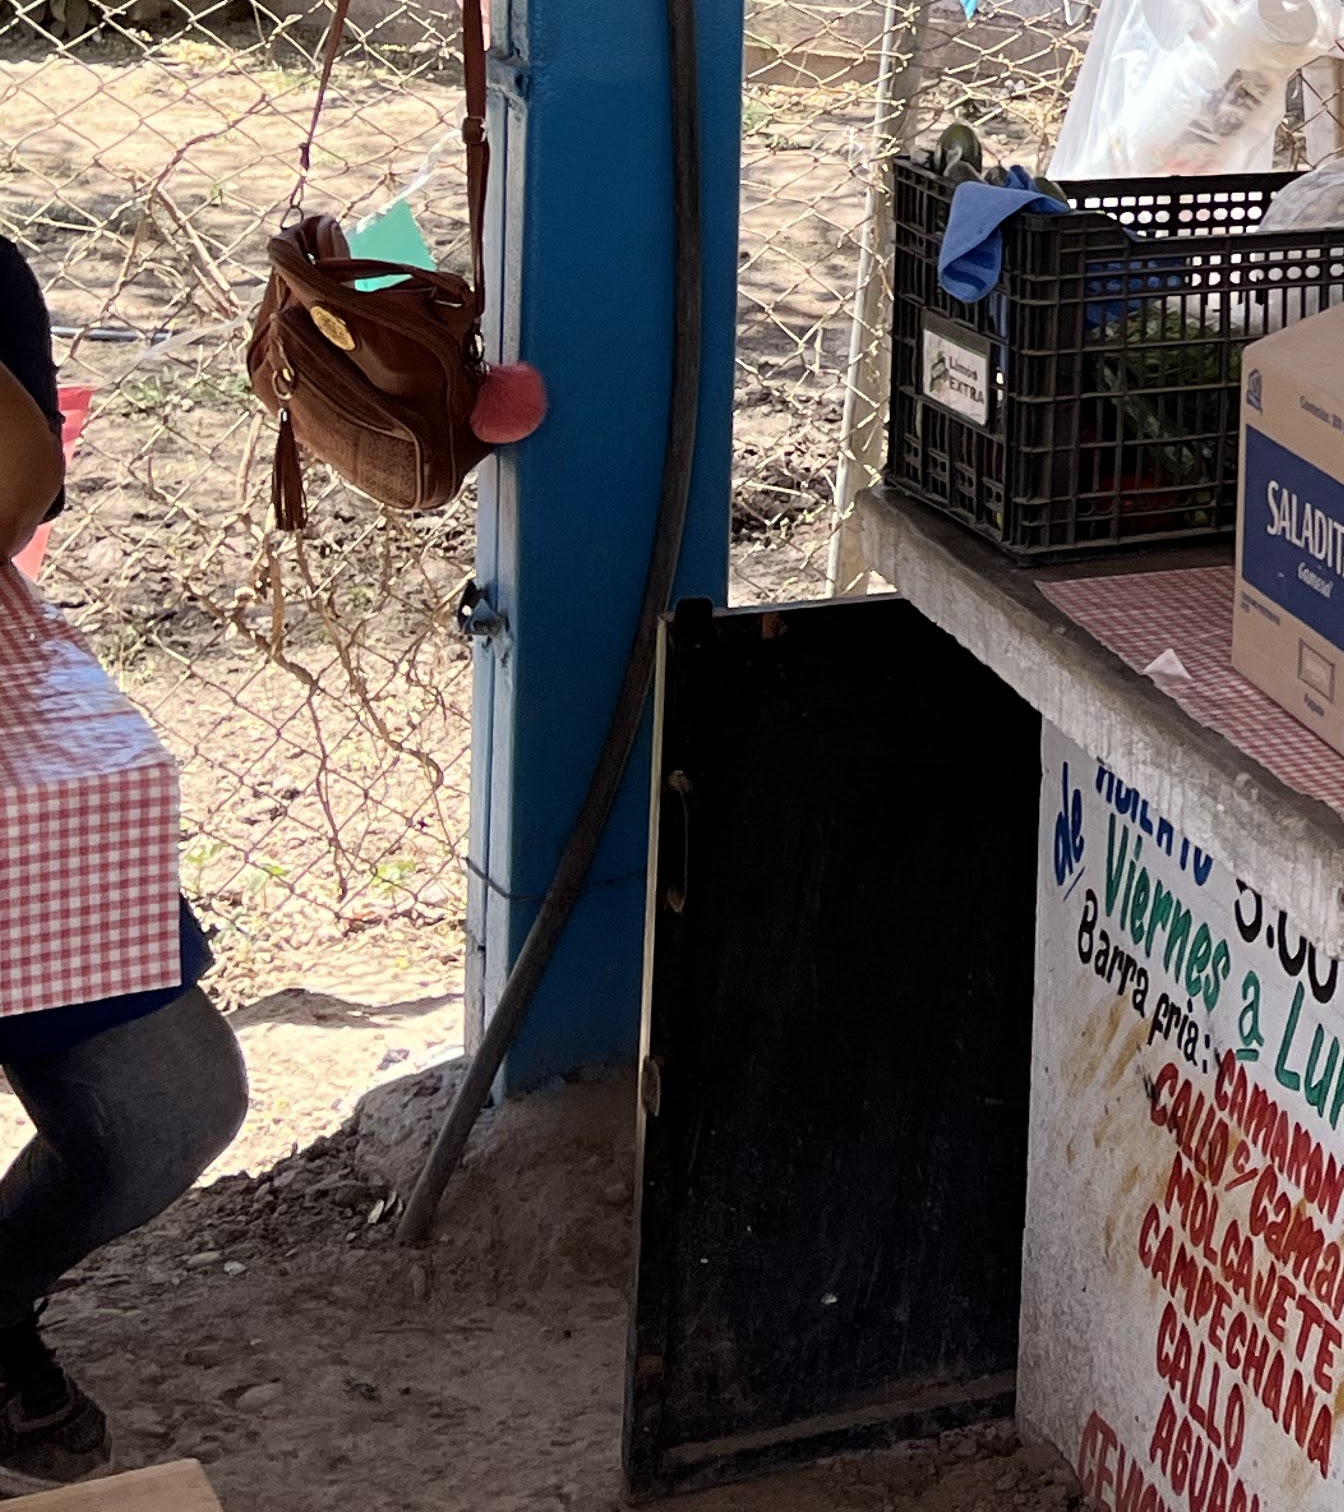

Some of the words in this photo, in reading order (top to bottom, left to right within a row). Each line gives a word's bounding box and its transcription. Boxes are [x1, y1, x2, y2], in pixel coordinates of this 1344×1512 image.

[949, 374, 985, 405] EXTRA
[1054, 760, 1085, 887] de
[1105, 812, 1231, 1013] Viernes
[1238, 969, 1265, 1048] a
[1078, 888, 1149, 1019] Barra
[1150, 1062, 1229, 1187] CALLO
[1138, 1202, 1334, 1480] CAMPECHANA
[1156, 1300, 1246, 1471] CALLO
[1149, 1391, 1260, 1512] AGUA
